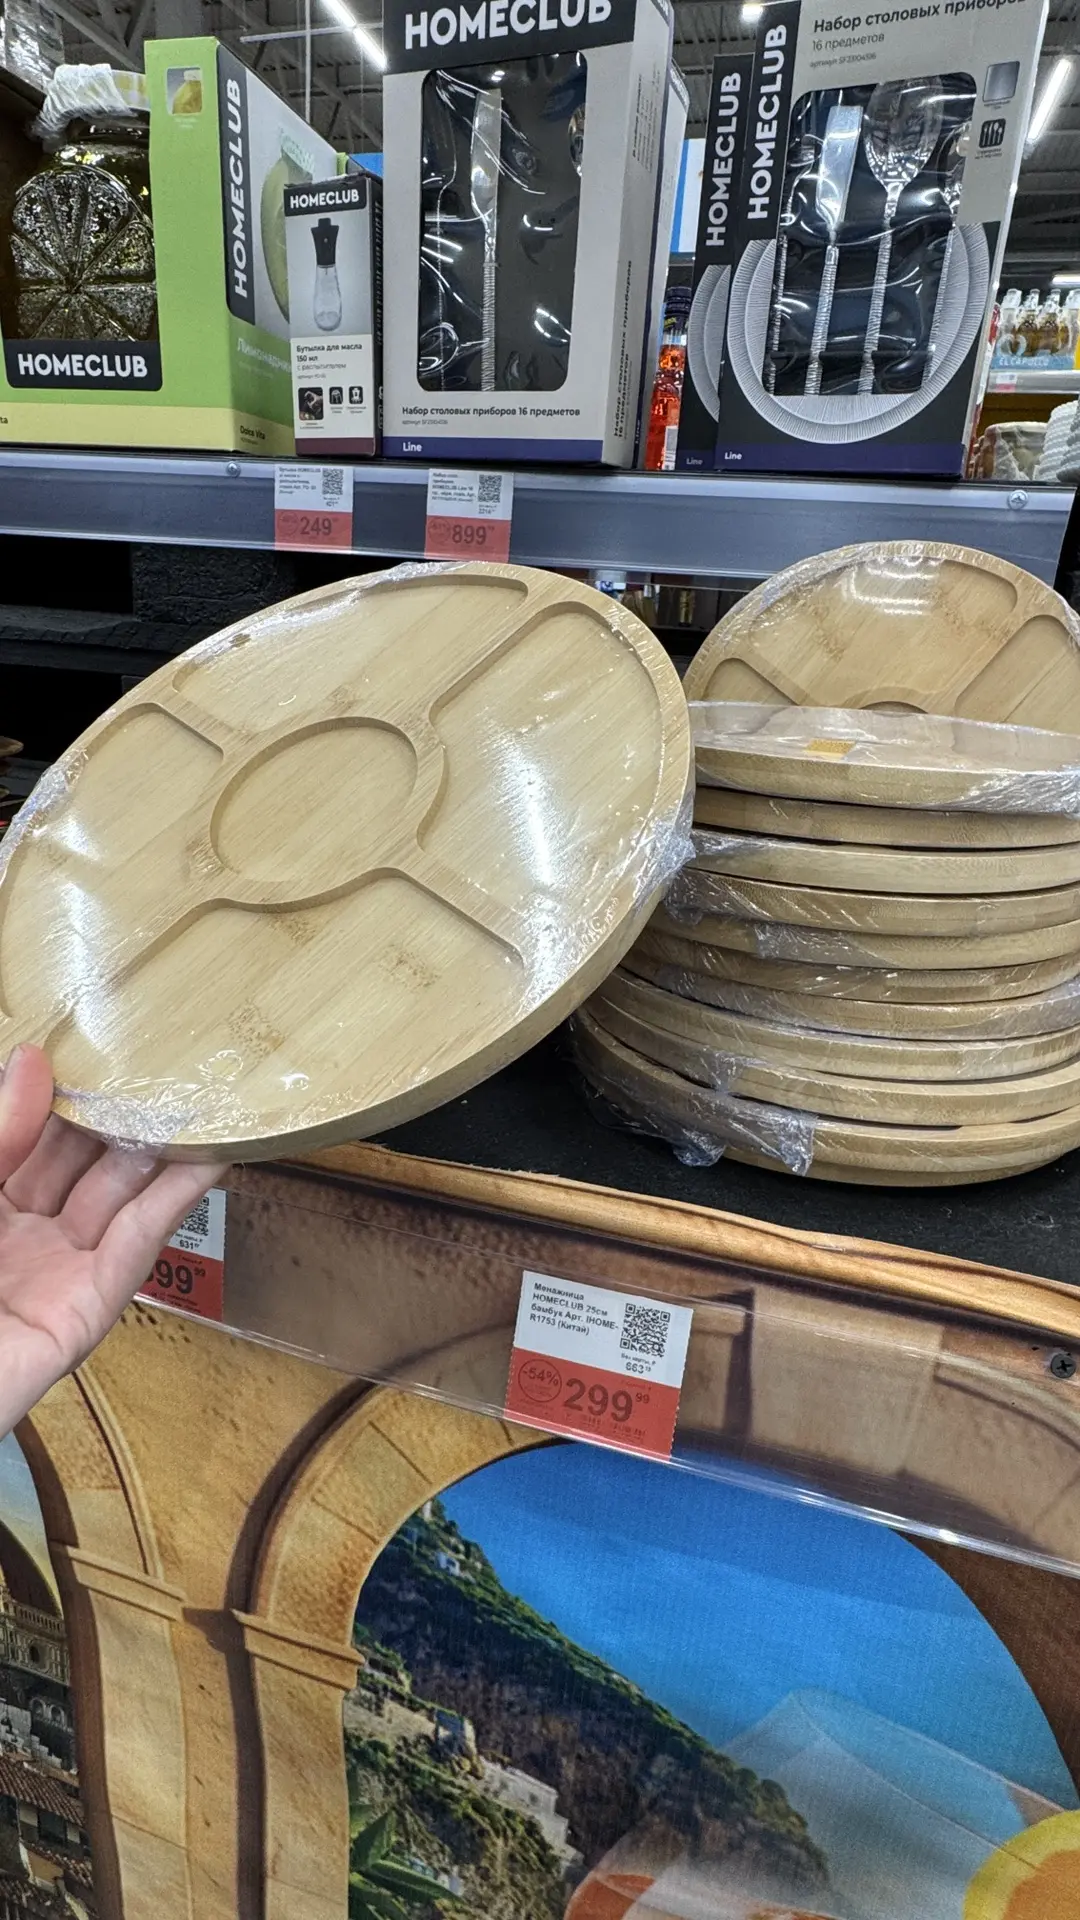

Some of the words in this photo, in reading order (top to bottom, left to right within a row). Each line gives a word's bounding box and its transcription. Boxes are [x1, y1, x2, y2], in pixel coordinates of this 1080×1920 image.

[404, 0, 612, 50] HOMECLUB
[813, 15, 862, 33] Набор
[865, 3, 940, 26] столовых
[944, 0, 1026, 16] прибор
[812, 40, 823, 52] 16
[824, 32, 885, 50] предметов
[747, 23, 787, 221] HOMECLUB
[705, 71, 742, 247] HOMECLUB
[225, 77, 248, 298] HOMECLUB
[290, 188, 360, 209] HOMECLUB
[296, 345, 325, 353] Бутылка
[326, 344, 340, 352] для
[17, 353, 148, 378] HOMECLUB
[402, 406, 429, 416] Набор
[430, 407, 471, 415] столовых
[472, 406, 517, 418] приборов
[518, 407, 528, 416] 16
[529, 408, 581, 417] предметов
[402, 442, 423, 452] Line
[724, 451, 743, 460] Line
[686, 457, 703, 465] Line
[300, 516, 332, 536] 249
[452, 524, 487, 545] 899
[145, 1258, 193, 1294] 99
[533, 1282, 585, 1301] Менажница
[532, 1293, 584, 1311] HOMECLUB
[585, 1305, 608, 1317] 25см
[529, 1314, 556, 1327] R1753
[557, 1319, 590, 1336] (Китай)
[531, 1303, 564, 1318] бамбук
[564, 1310, 584, 1323] Арт.
[586, 1315, 619, 1330] IHOME-
[523, 1366, 559, 1386] -54%
[625, 1361, 645, 1374] 663
[563, 1377, 633, 1423] 299
[635, 1392, 650, 1404] 99
